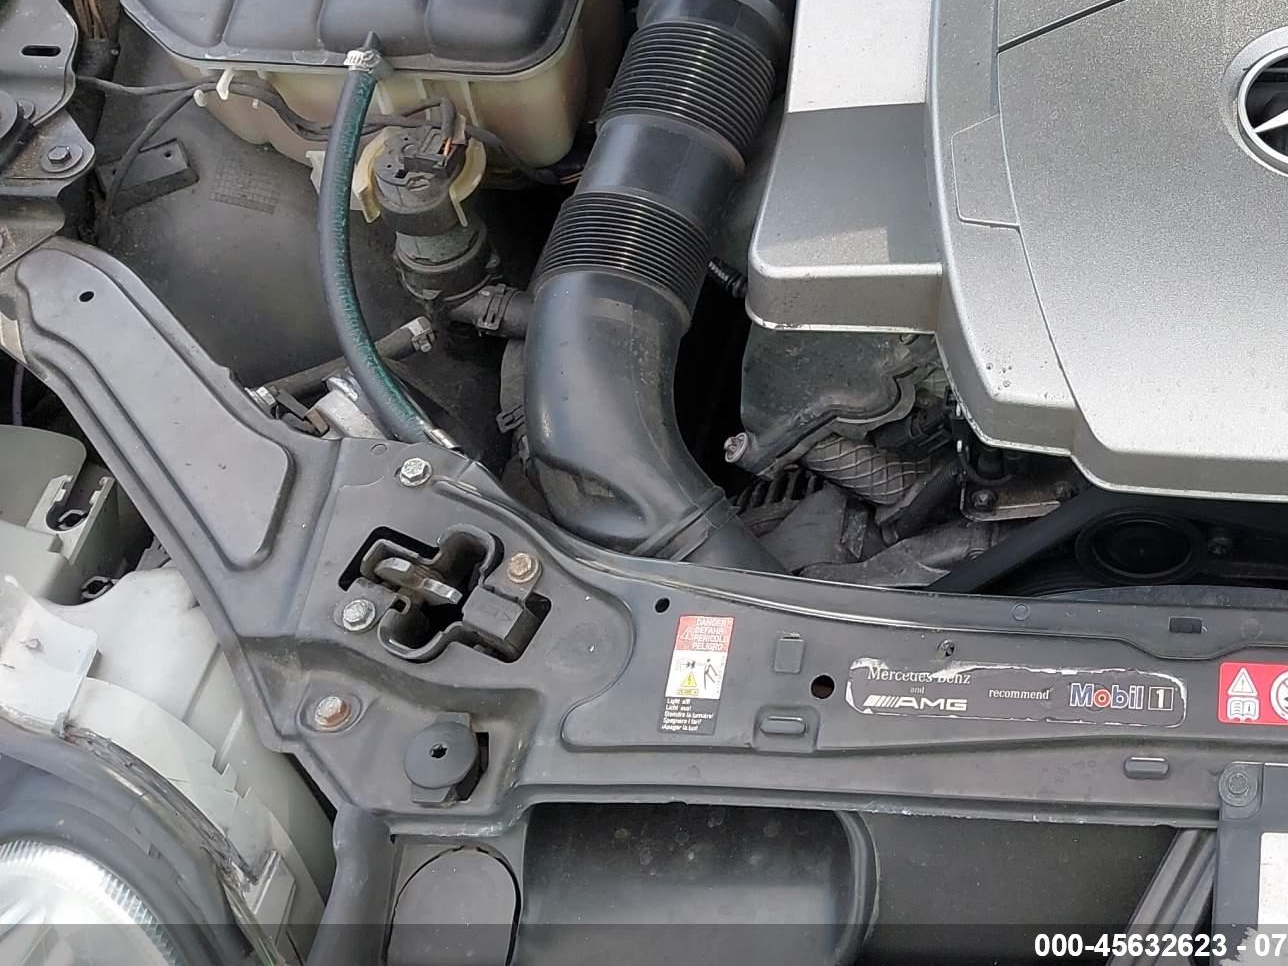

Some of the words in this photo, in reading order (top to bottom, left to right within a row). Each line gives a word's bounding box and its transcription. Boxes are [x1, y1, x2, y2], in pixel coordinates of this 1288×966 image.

[894, 696, 968, 711] AMG
[989, 688, 1050, 700] recommend
[1069, 682, 1145, 710] Mobil
[910, 686, 925, 694] and
